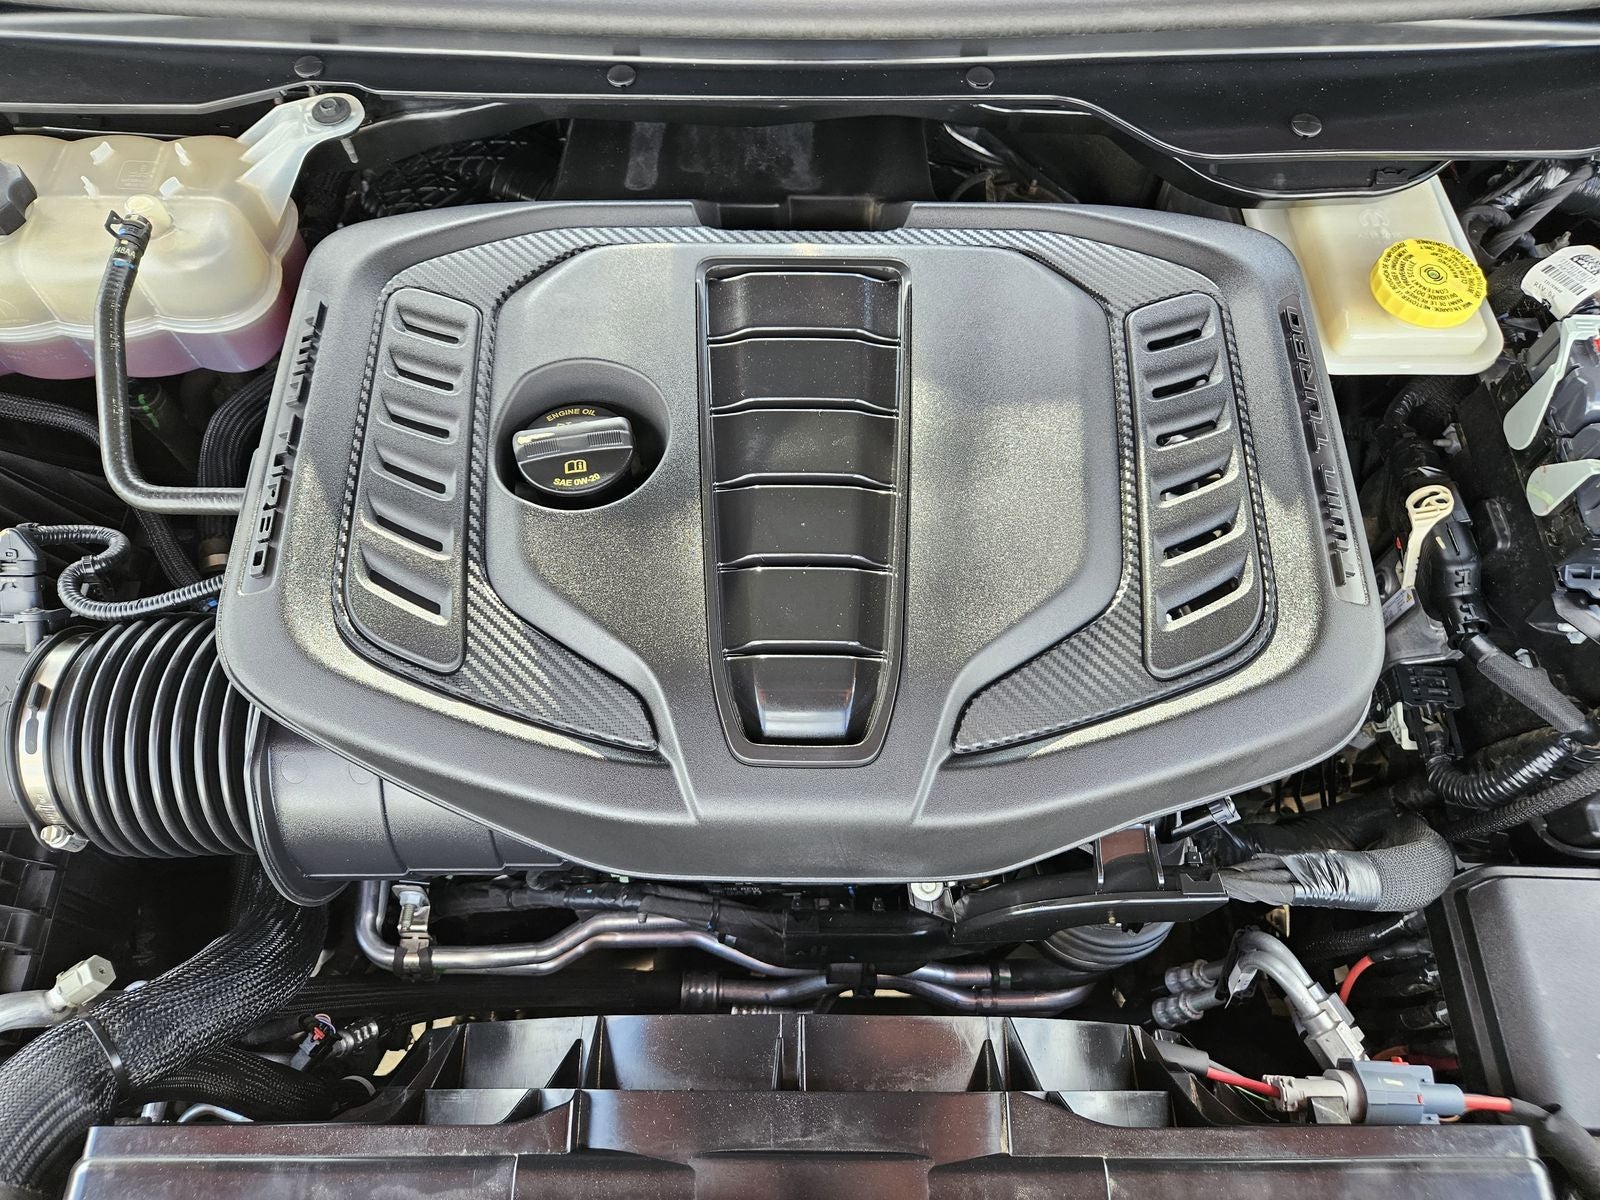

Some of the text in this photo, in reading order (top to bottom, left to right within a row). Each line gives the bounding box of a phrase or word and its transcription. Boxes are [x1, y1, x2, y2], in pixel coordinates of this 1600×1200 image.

[1411, 279, 1449, 294] CONTENANT
[1413, 288, 1425, 296] DOT
[546, 408, 597, 422] ENGINE OIL
[248, 301, 328, 580] TWIN TURBO
[1278, 304, 1356, 586] TWIN TURBO
[553, 473, 601, 487] SAE 0W-20
